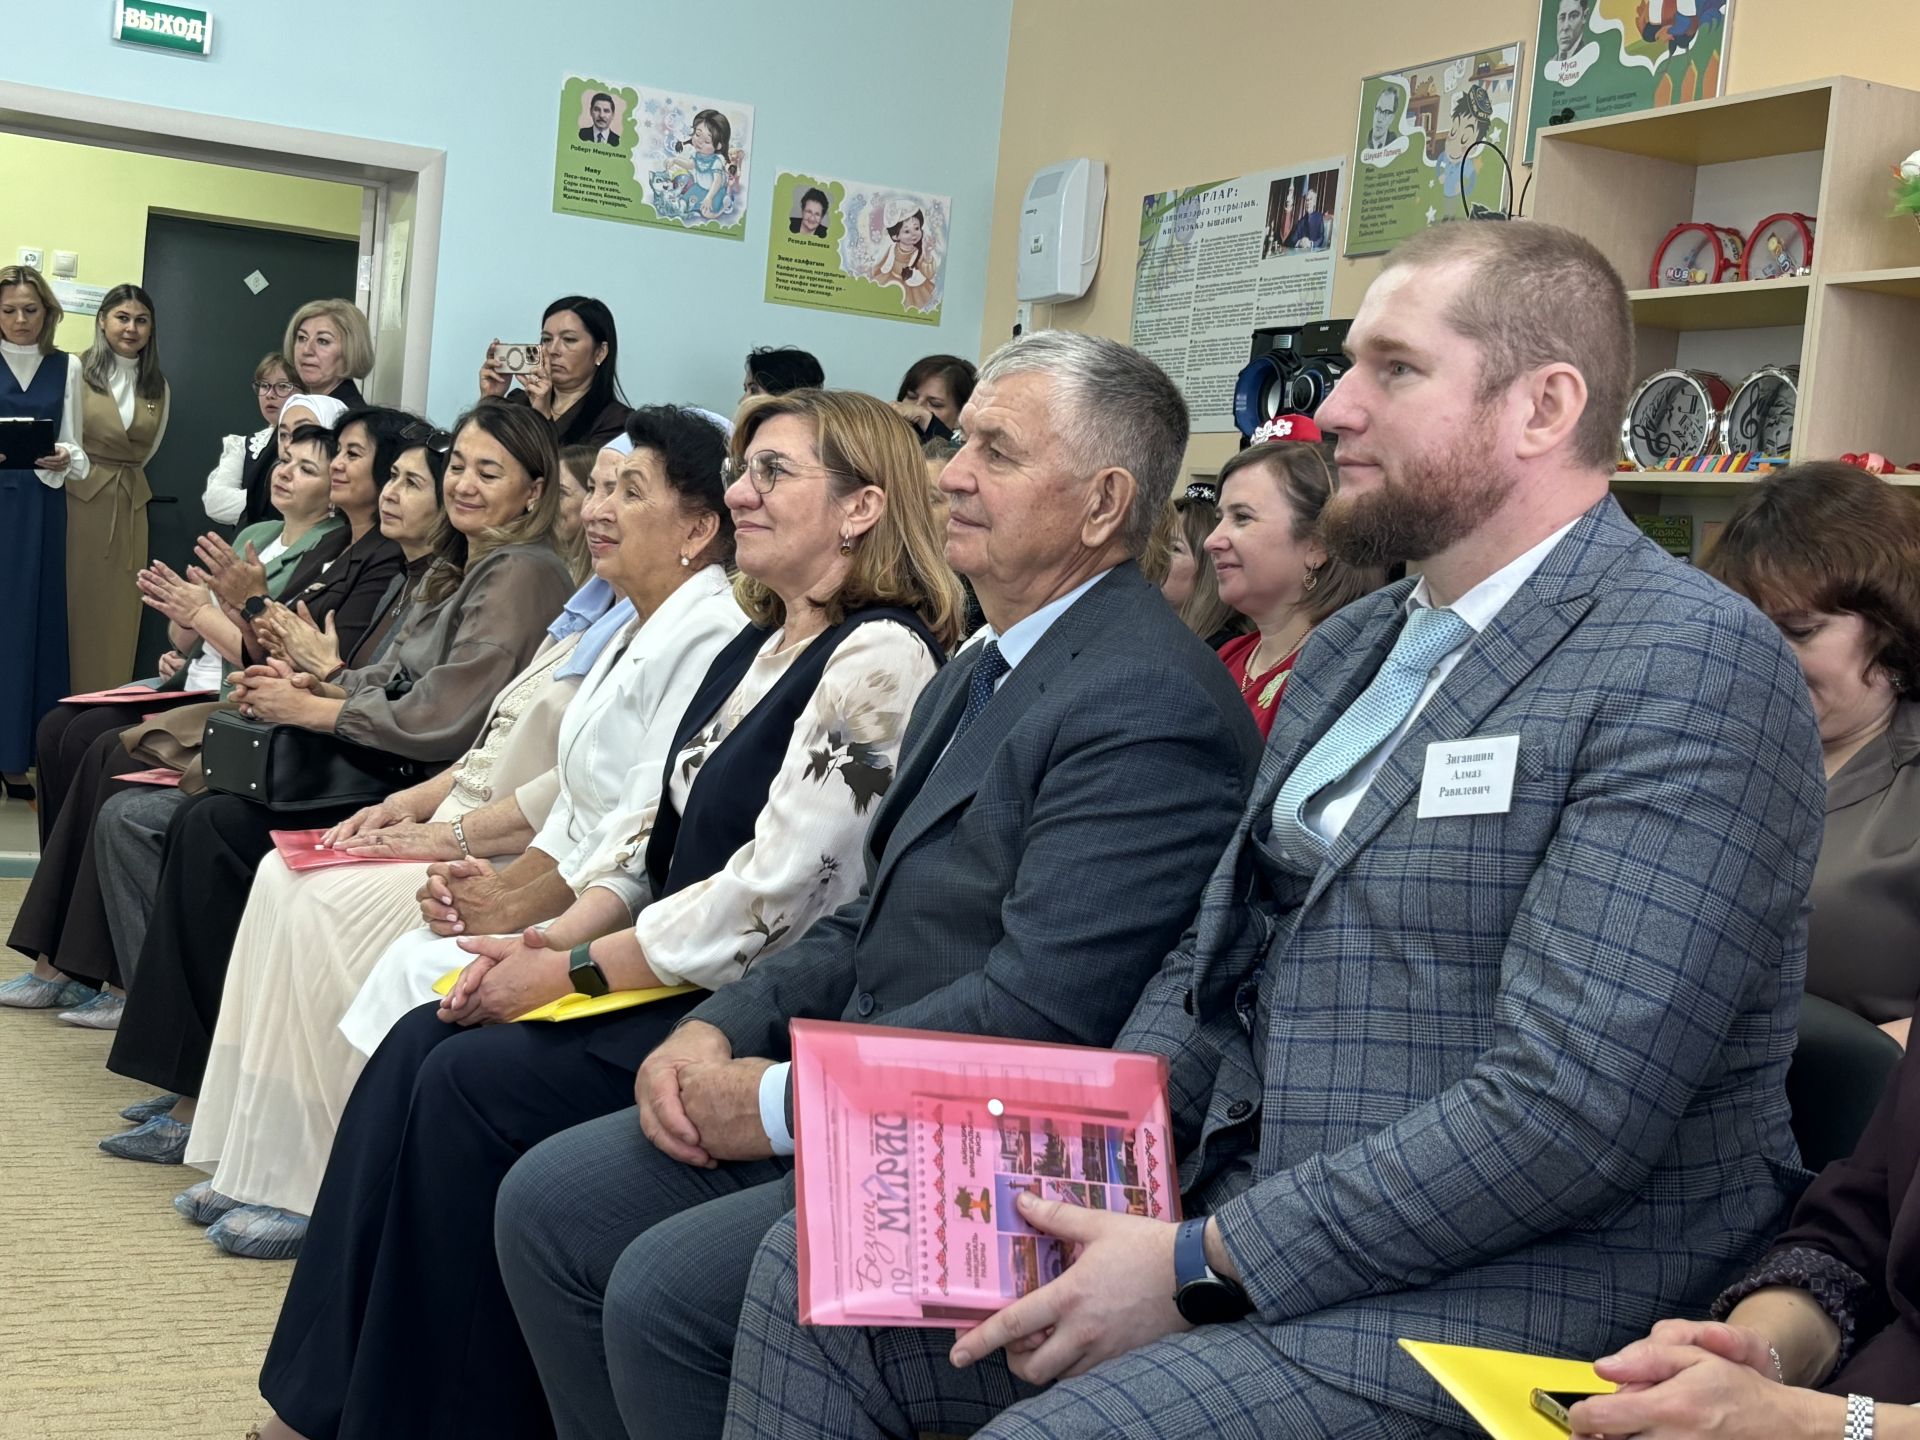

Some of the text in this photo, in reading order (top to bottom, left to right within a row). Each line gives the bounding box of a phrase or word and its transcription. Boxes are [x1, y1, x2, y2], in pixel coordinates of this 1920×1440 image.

[125, 7, 203, 43] ВЫХОД
[1560, 59, 1578, 73] Муса
[570, 144, 591, 155] Роберт
[1445, 752, 1494, 765] Зиганшин
[1451, 769, 1482, 780] Алмаз
[1439, 785, 1491, 797] Равилевич
[874, 1110, 911, 1235] МИРАС
[856, 1200, 895, 1292] Безнең
